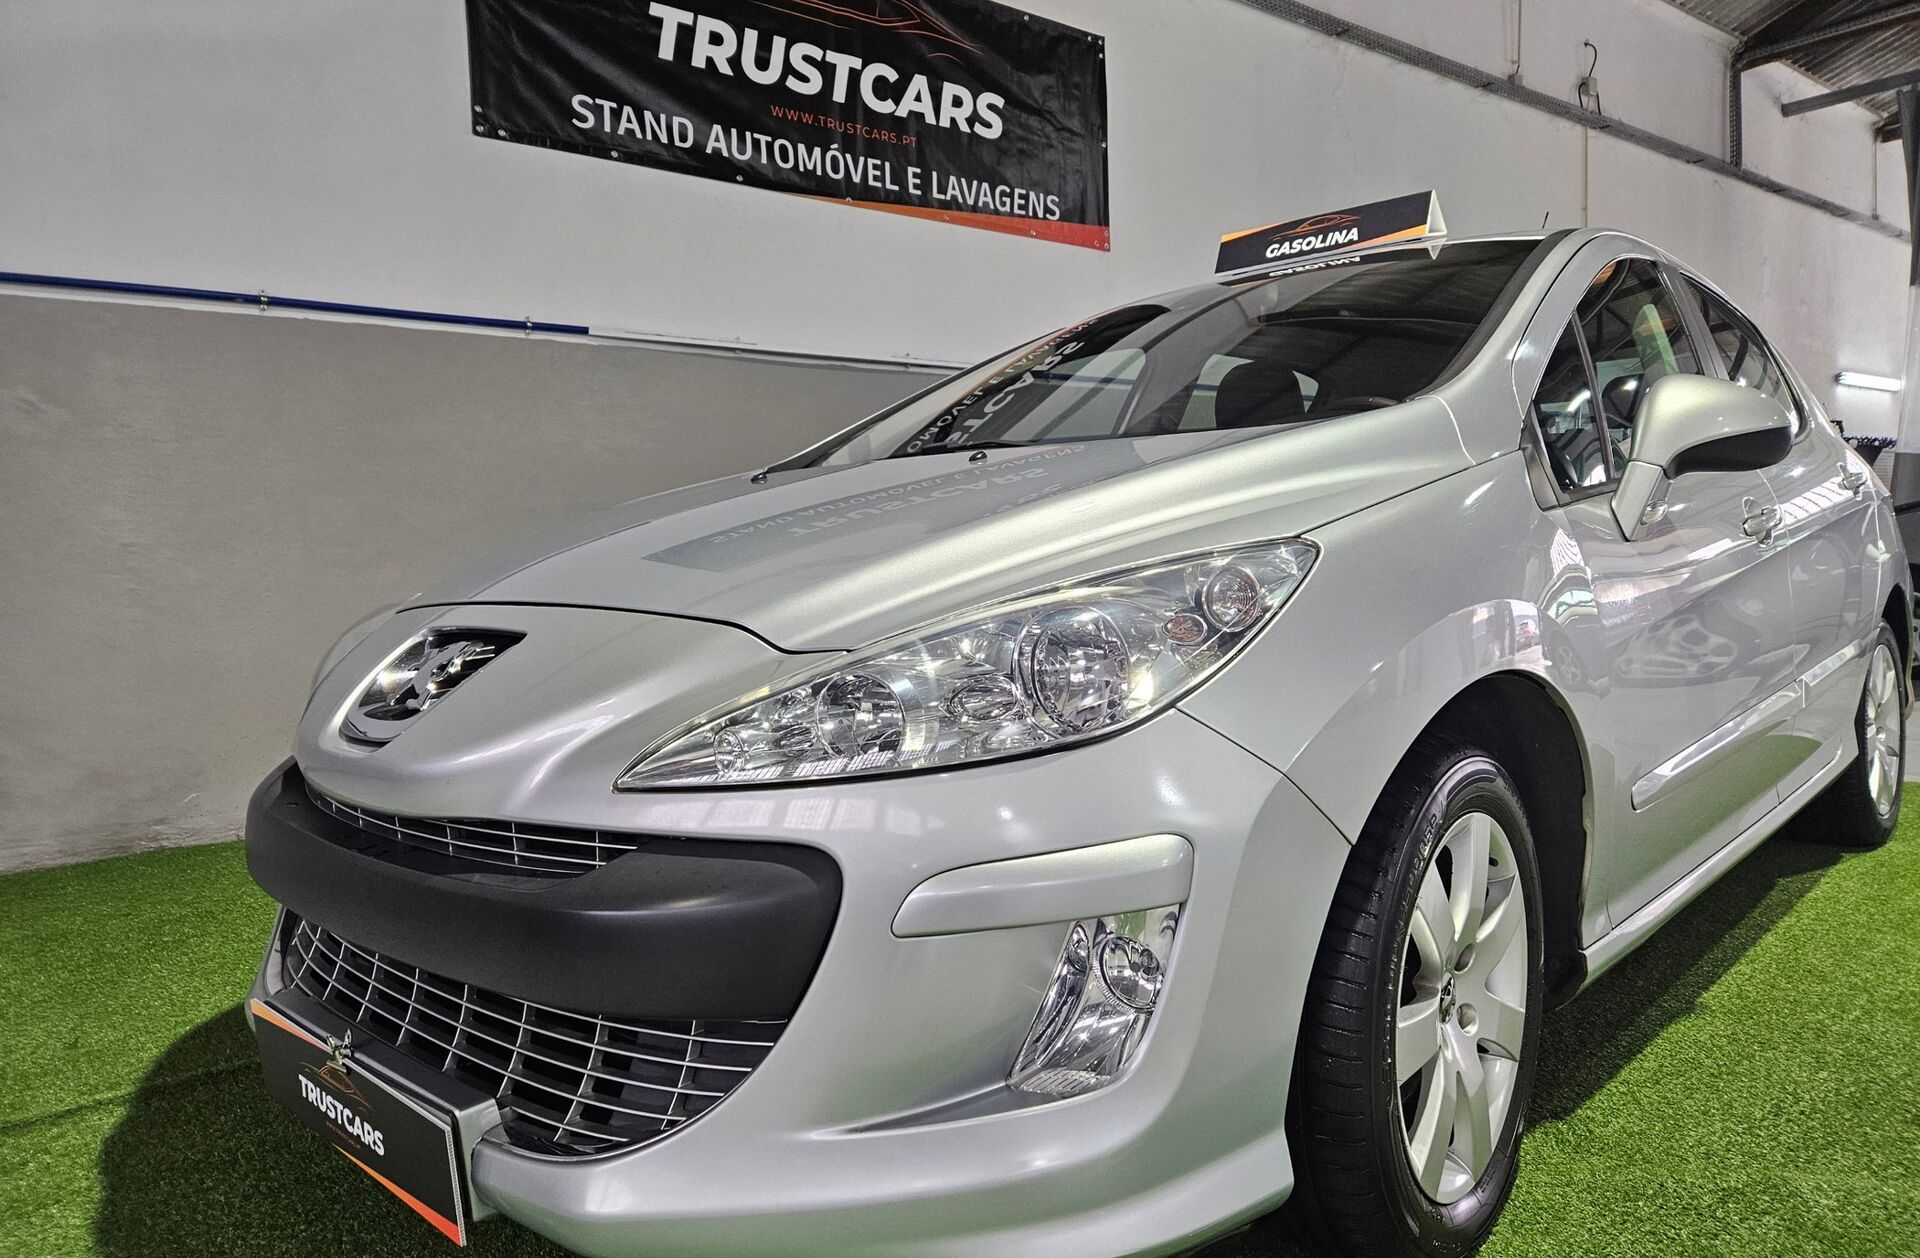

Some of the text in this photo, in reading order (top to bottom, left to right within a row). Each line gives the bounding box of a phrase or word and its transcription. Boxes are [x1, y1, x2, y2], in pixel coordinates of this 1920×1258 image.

[648, 2, 1005, 140] TRUSTCARS
[571, 94, 1061, 221] STAND AUTOMÓVEL E LAVAGENS
[771, 104, 918, 149] WWW.TRUSTCARS.PT
[1265, 227, 1359, 259] GASOLINA
[298, 1074, 385, 1156] TRUSTCARS
